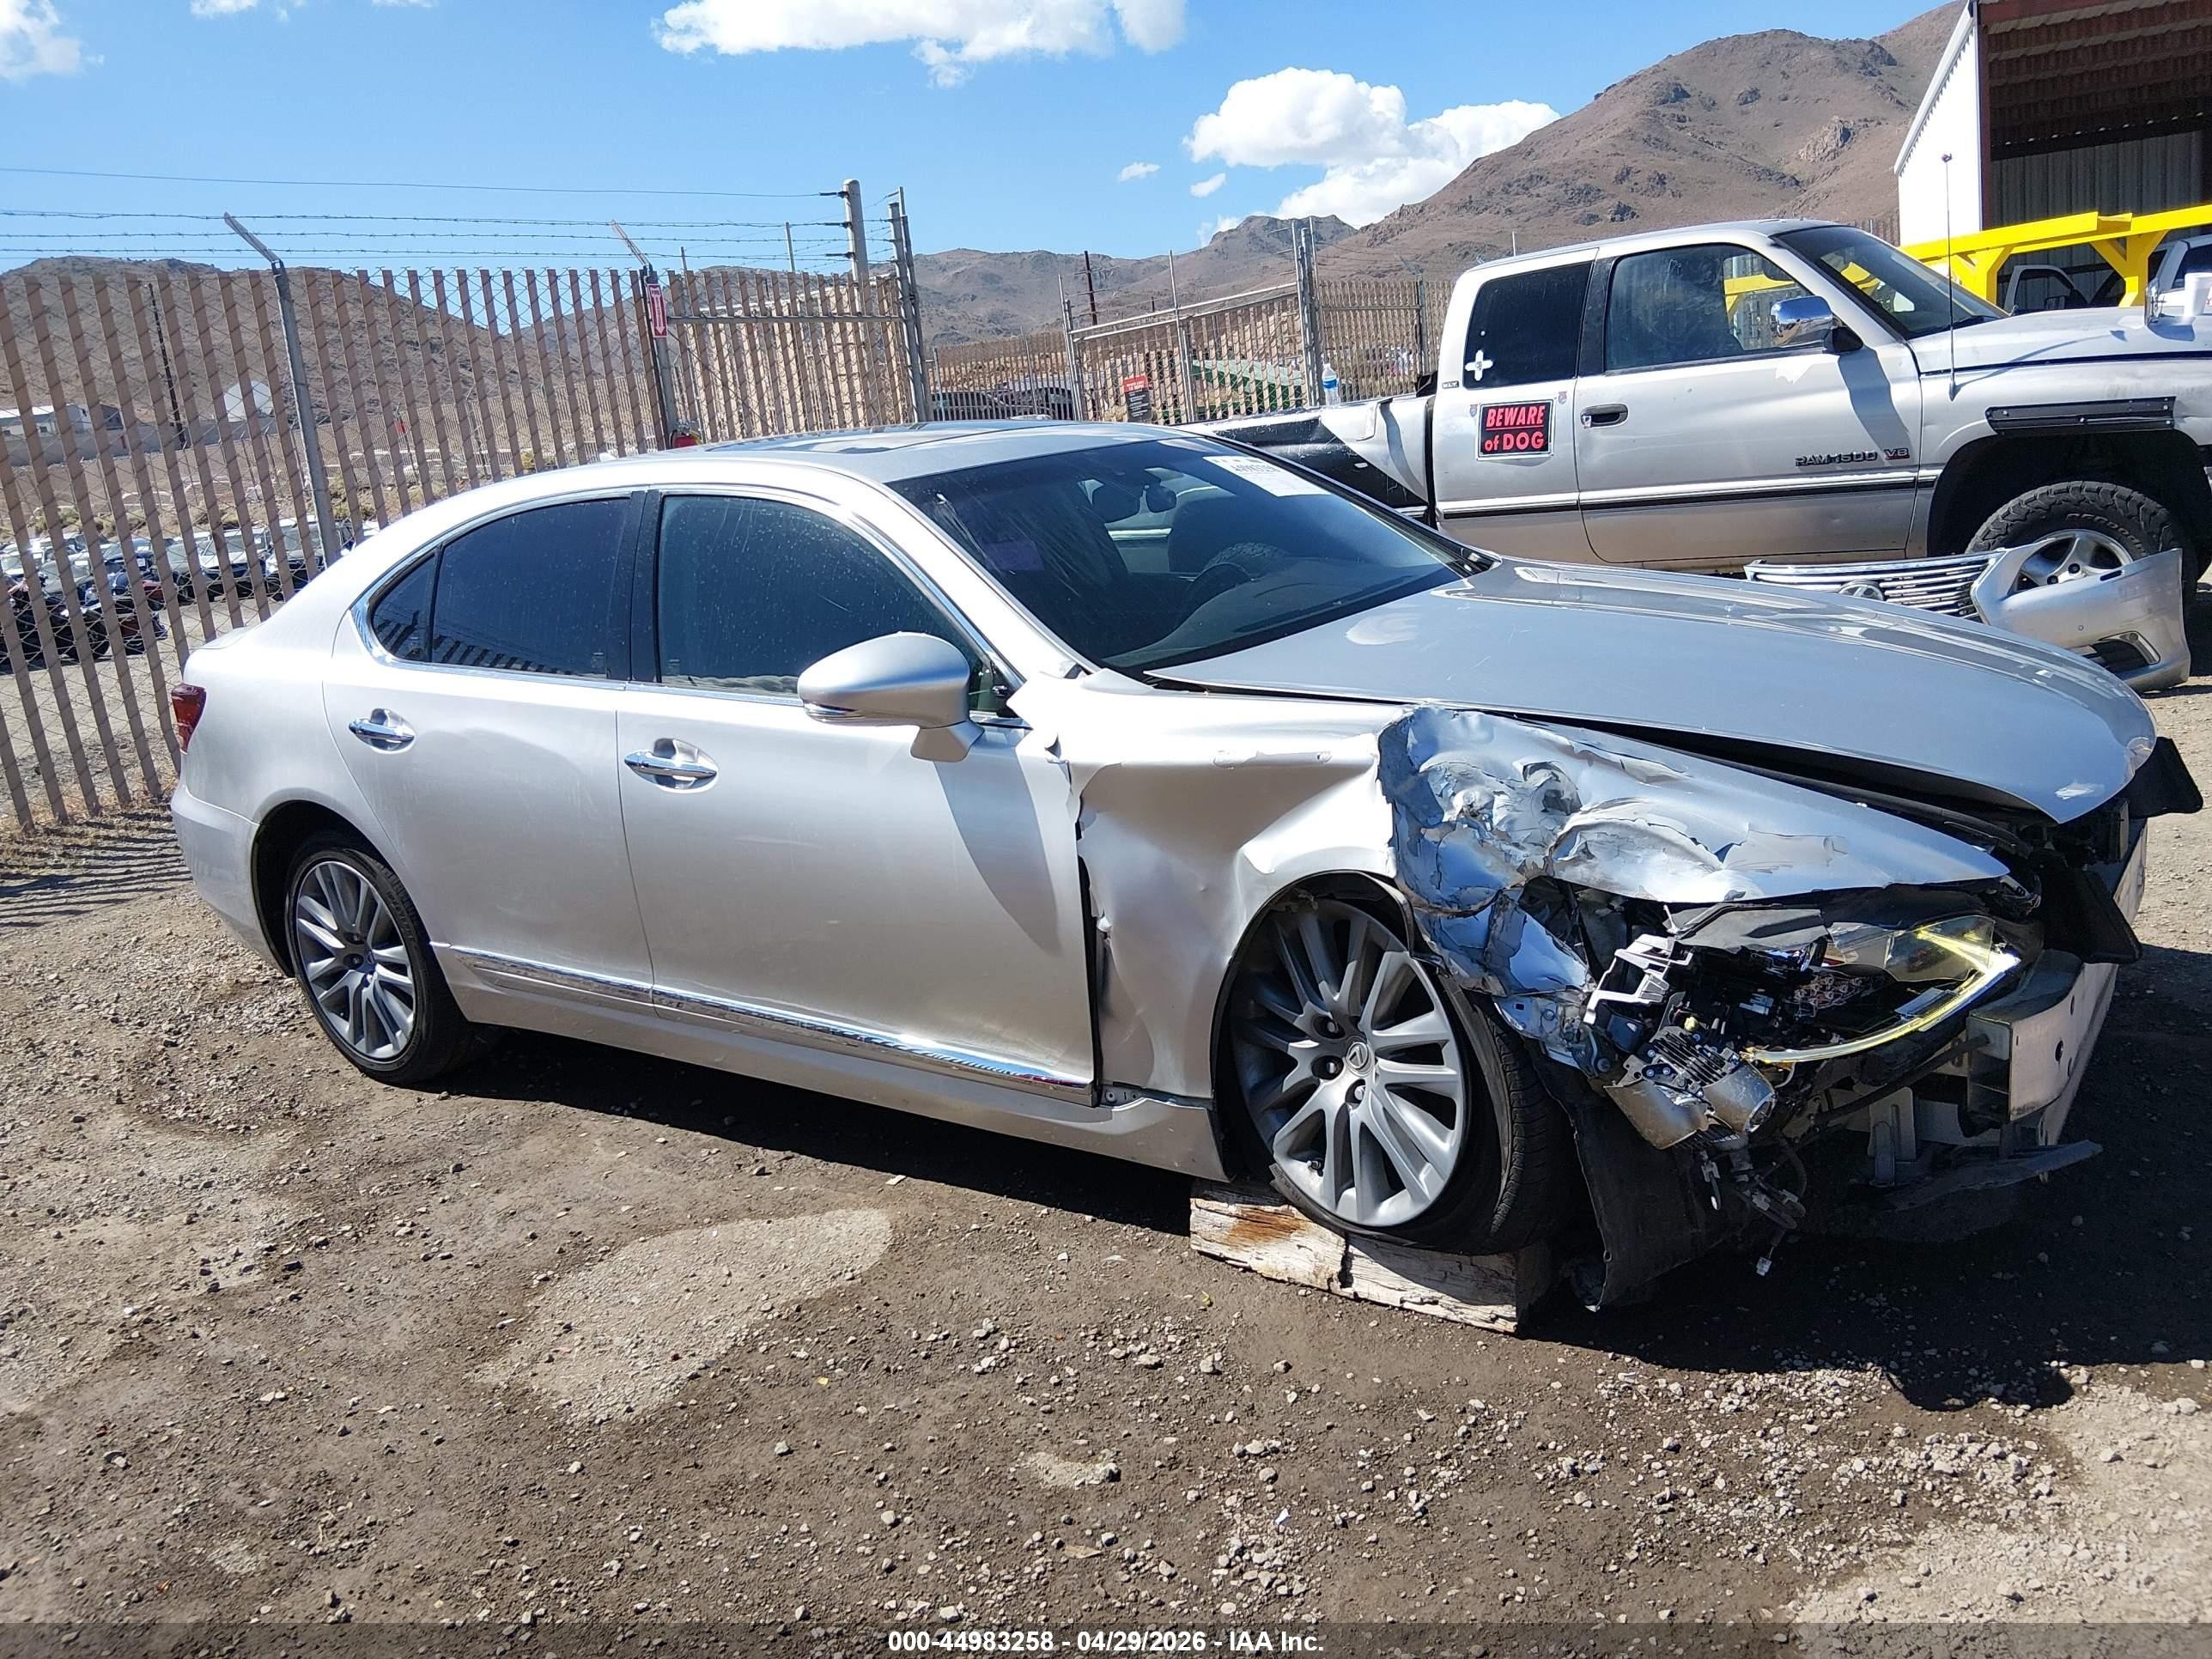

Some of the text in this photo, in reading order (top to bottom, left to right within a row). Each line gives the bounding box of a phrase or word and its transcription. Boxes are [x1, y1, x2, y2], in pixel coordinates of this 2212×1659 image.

[1486, 405, 1546, 428] BEWARE
[1484, 431, 1544, 452] of DOG
[1884, 447, 1909, 459] V8
